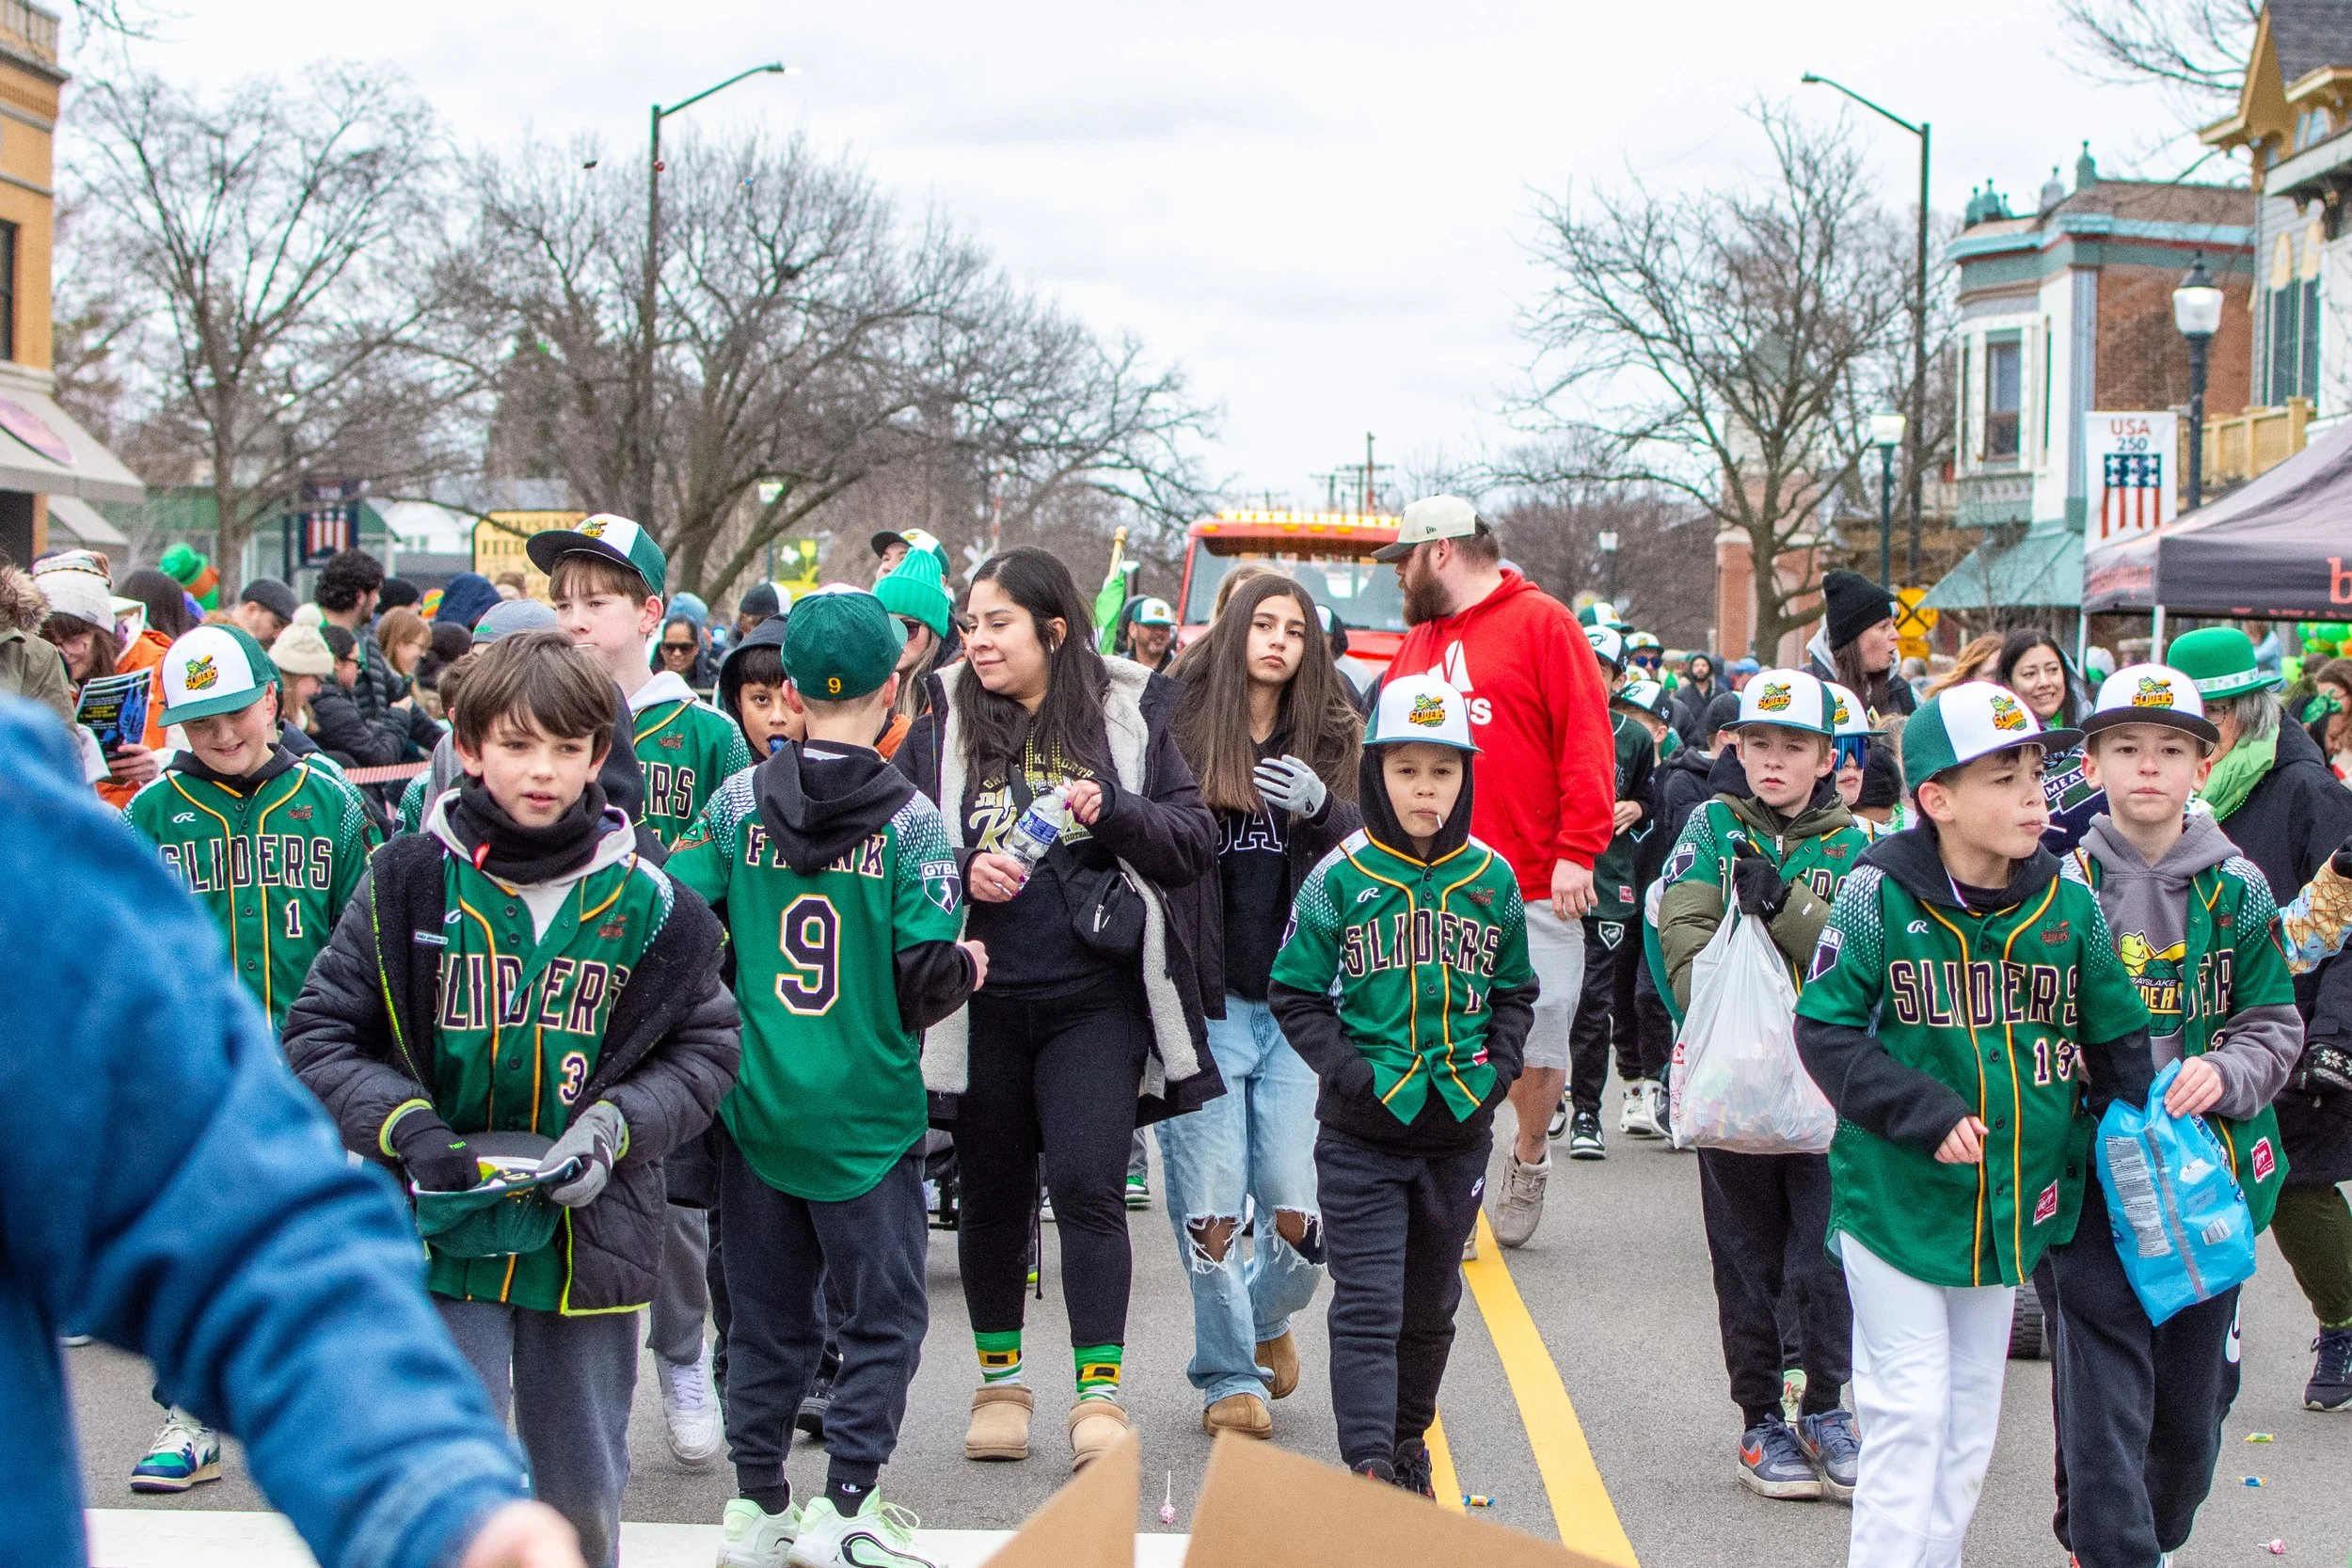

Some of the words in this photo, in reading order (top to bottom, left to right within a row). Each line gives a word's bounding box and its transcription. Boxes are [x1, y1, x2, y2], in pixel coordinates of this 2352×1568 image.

[2110, 419, 2152, 436] USA
[2116, 436, 2149, 451] 250
[185, 665, 218, 691] SLIDERS
[828, 677, 841, 694] 9
[1756, 694, 1791, 711] SLIDERS
[2132, 691, 2174, 707] SLIDERS
[1408, 707, 1446, 724] SLIDERS
[158, 833, 333, 894] SLIDERS
[923, 863, 960, 877] GYBA
[285, 899, 304, 939] 1
[1343, 909, 1502, 978] SLIDERS
[774, 894, 840, 1016] 9
[2033, 1037, 2076, 1085] 13
[558, 1051, 589, 1106] 3
